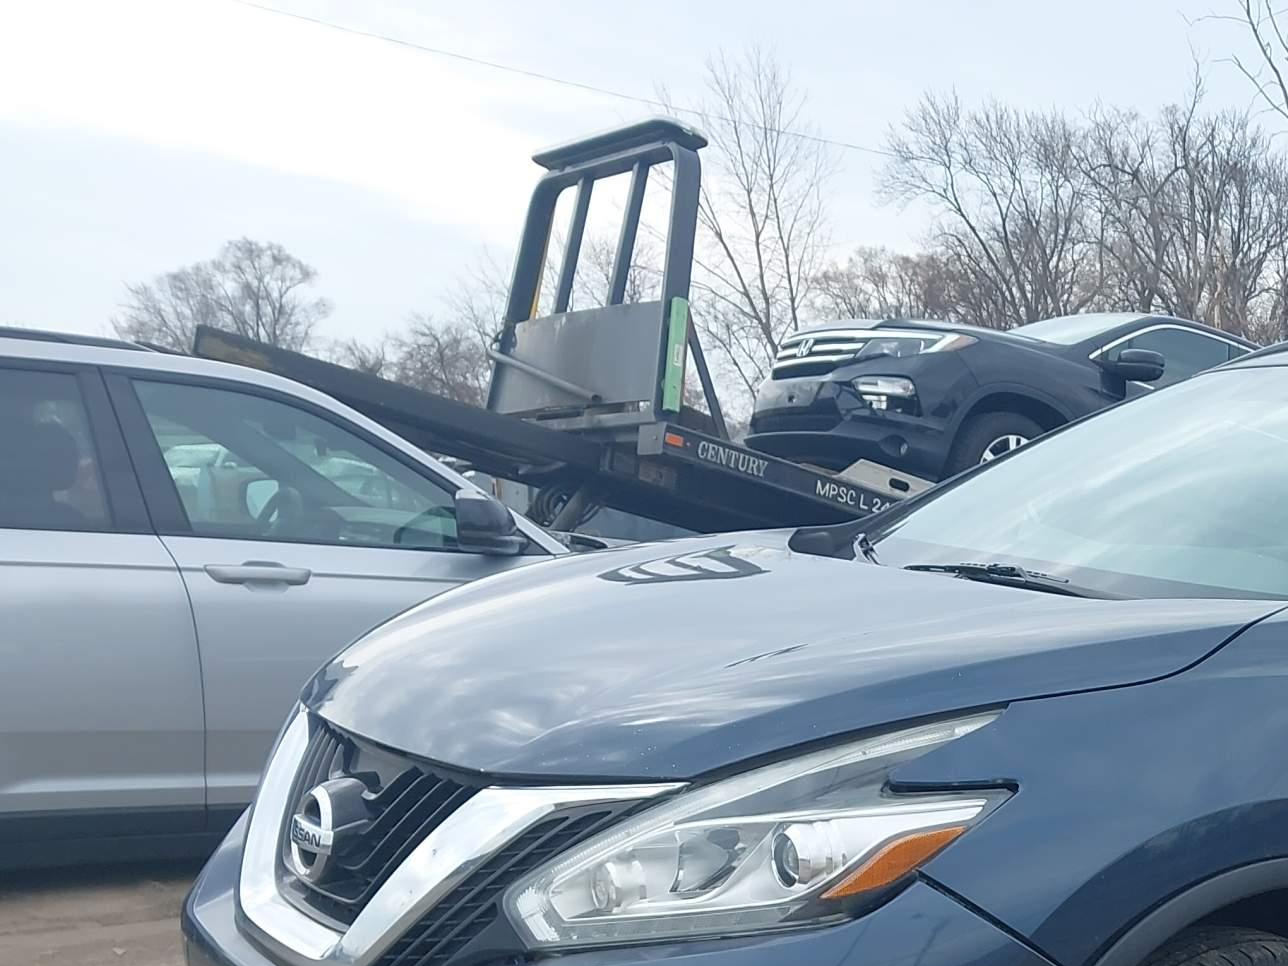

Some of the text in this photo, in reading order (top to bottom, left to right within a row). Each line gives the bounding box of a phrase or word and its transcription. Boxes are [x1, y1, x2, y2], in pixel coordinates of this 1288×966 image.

[698, 441, 768, 476] CENTURY
[816, 480, 855, 504] MPSC
[860, 494, 868, 510] L
